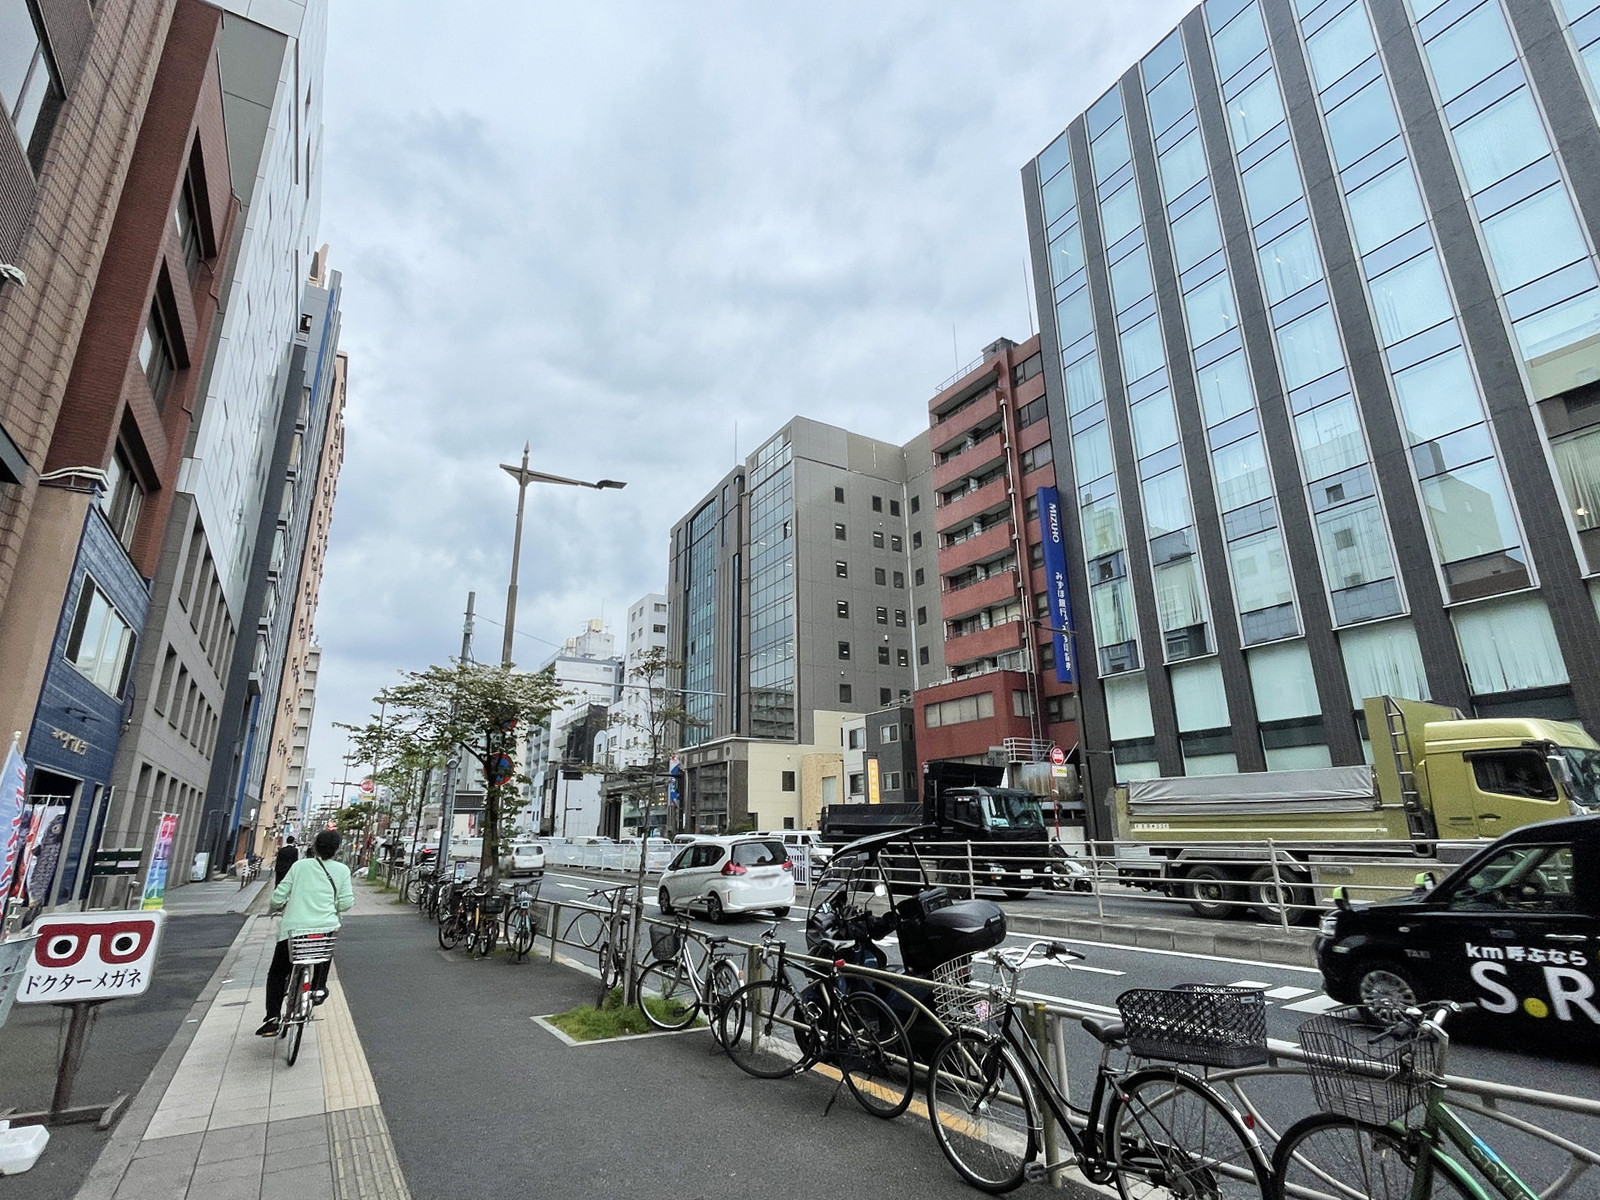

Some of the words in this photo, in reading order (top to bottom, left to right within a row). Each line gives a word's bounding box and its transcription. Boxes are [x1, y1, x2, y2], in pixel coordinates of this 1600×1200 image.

[1049, 503, 1060, 543] MIZUHO
[25, 968, 142, 995] ドクターメガネ
